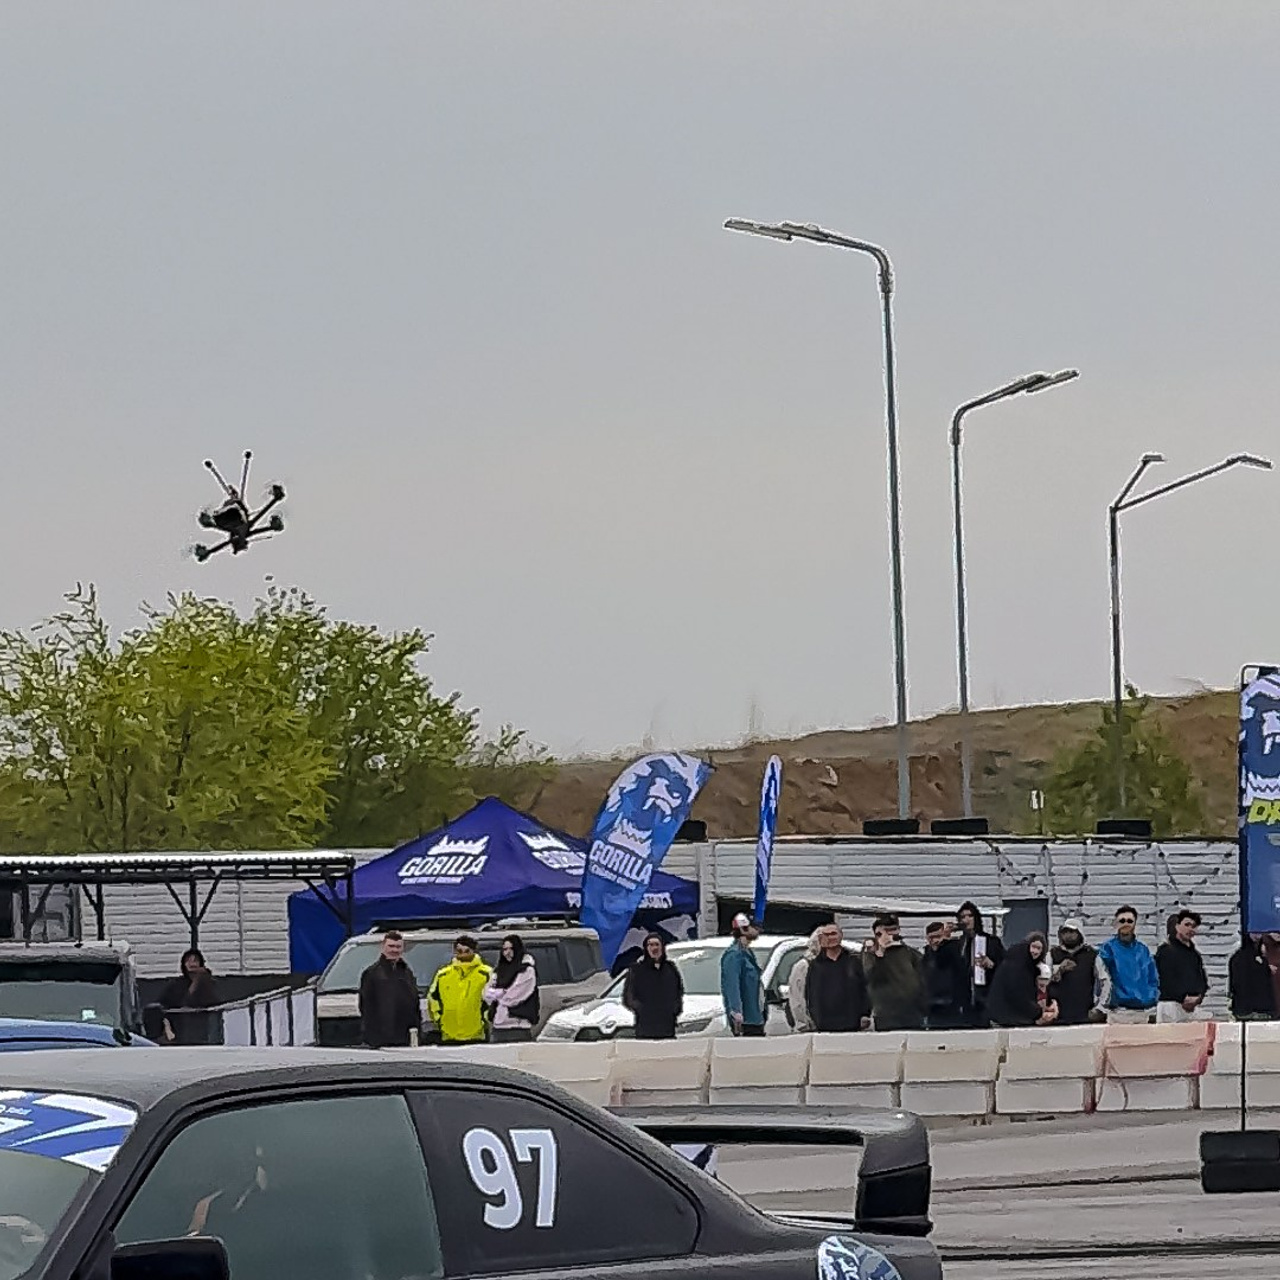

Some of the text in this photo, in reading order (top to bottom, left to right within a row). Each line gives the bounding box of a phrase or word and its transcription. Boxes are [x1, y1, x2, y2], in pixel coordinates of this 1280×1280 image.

[398, 855, 488, 876] GORILLA
[590, 839, 653, 885] GORILLA
[462, 1127, 557, 1229] 97
